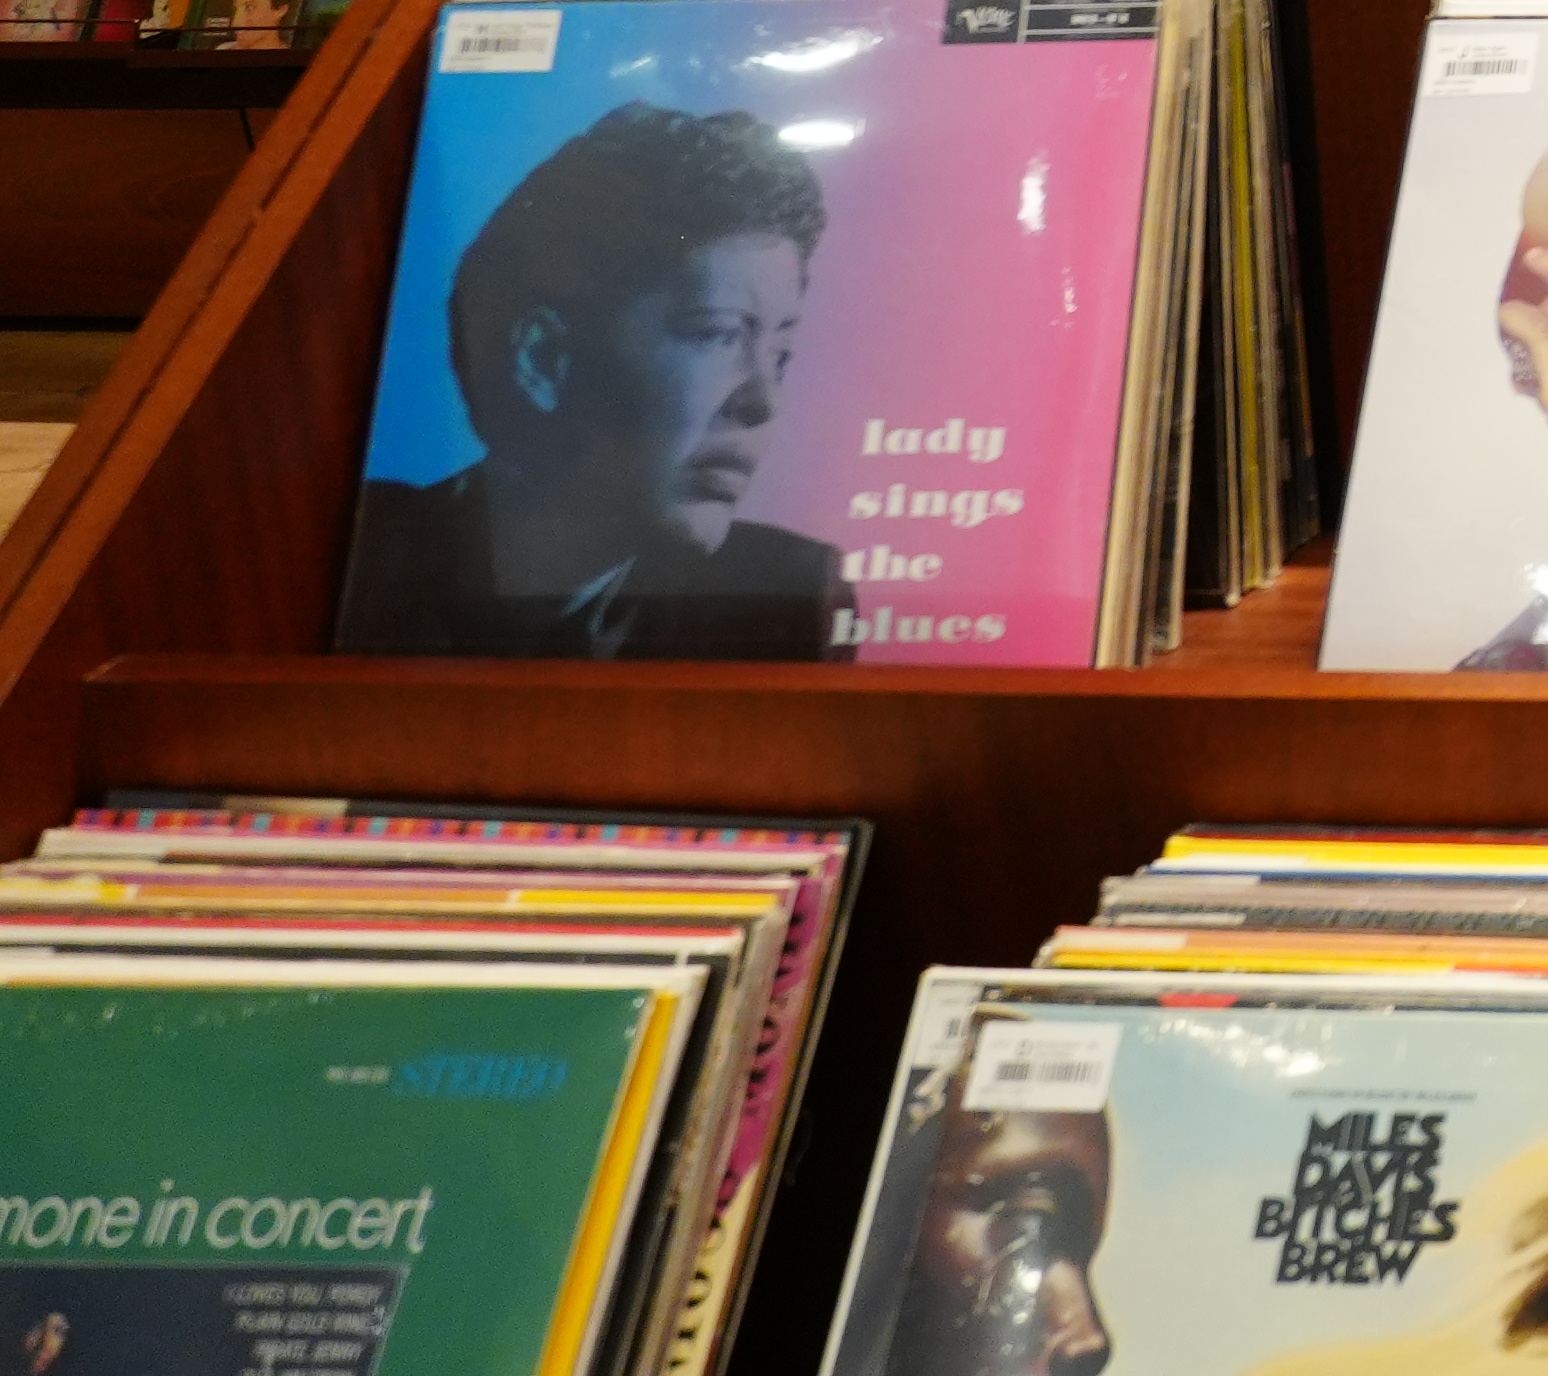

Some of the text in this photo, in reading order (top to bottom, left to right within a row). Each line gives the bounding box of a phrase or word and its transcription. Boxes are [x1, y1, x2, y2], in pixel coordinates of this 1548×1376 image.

[860, 420, 1006, 462] lady
[848, 485, 1023, 528] sings
[841, 548, 943, 582] the
[830, 607, 1006, 647] blues
[1304, 1111, 1445, 1154] MILES
[1292, 1150, 1438, 1203] DAVIS
[146, 1179, 435, 1254] in concert
[1253, 1197, 1458, 1244] BITCHES
[1274, 1244, 1420, 1285] BREW
